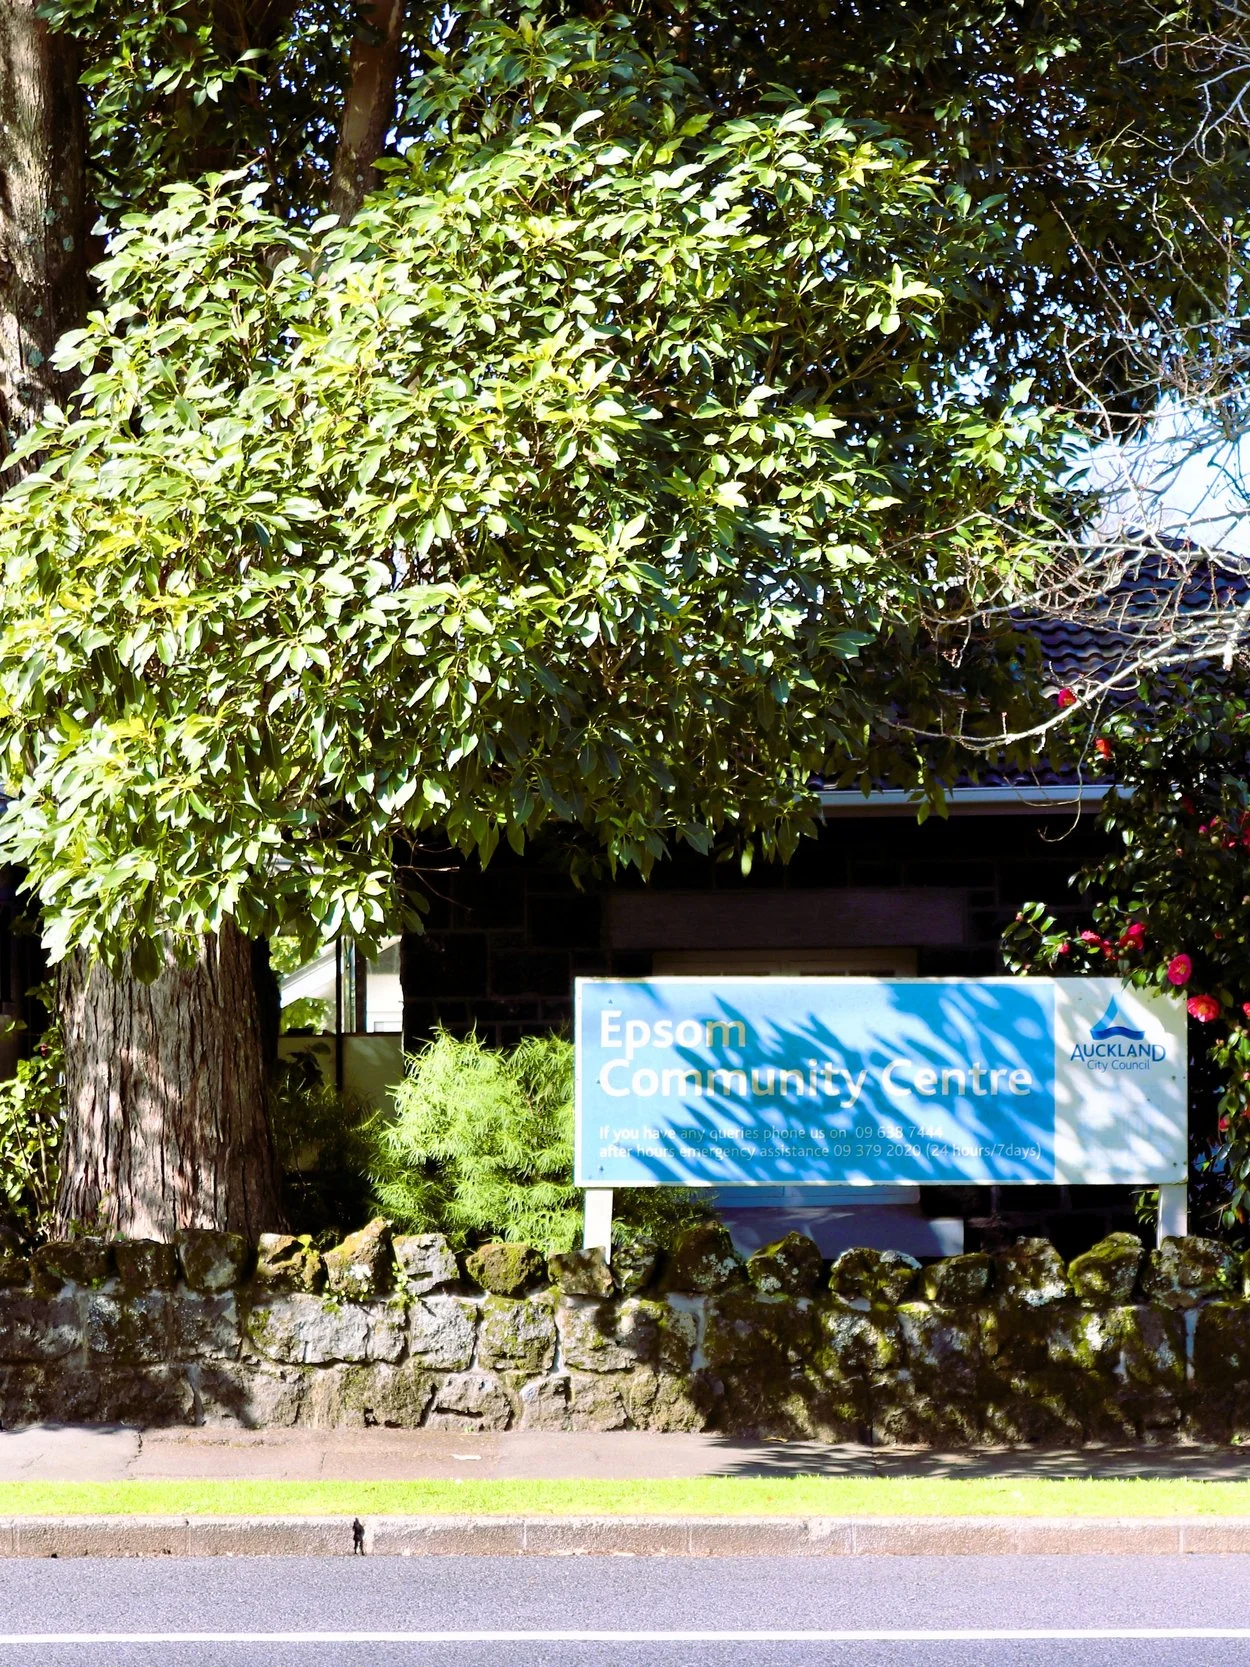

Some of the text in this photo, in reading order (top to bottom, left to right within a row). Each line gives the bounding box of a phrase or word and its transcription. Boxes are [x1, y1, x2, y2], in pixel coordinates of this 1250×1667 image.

[601, 1010, 746, 1060] Epsom
[1070, 1044, 1166, 1062] AUCKLAND
[1087, 1059, 1150, 1073] City Council
[599, 1058, 1033, 1108] Community Centre
[599, 1125, 945, 1143] If you have any queries phone us on 09 638 7444
[599, 1143, 1042, 1161] after hours emergency assistance 09 379 2020 (24 hours/7days)
